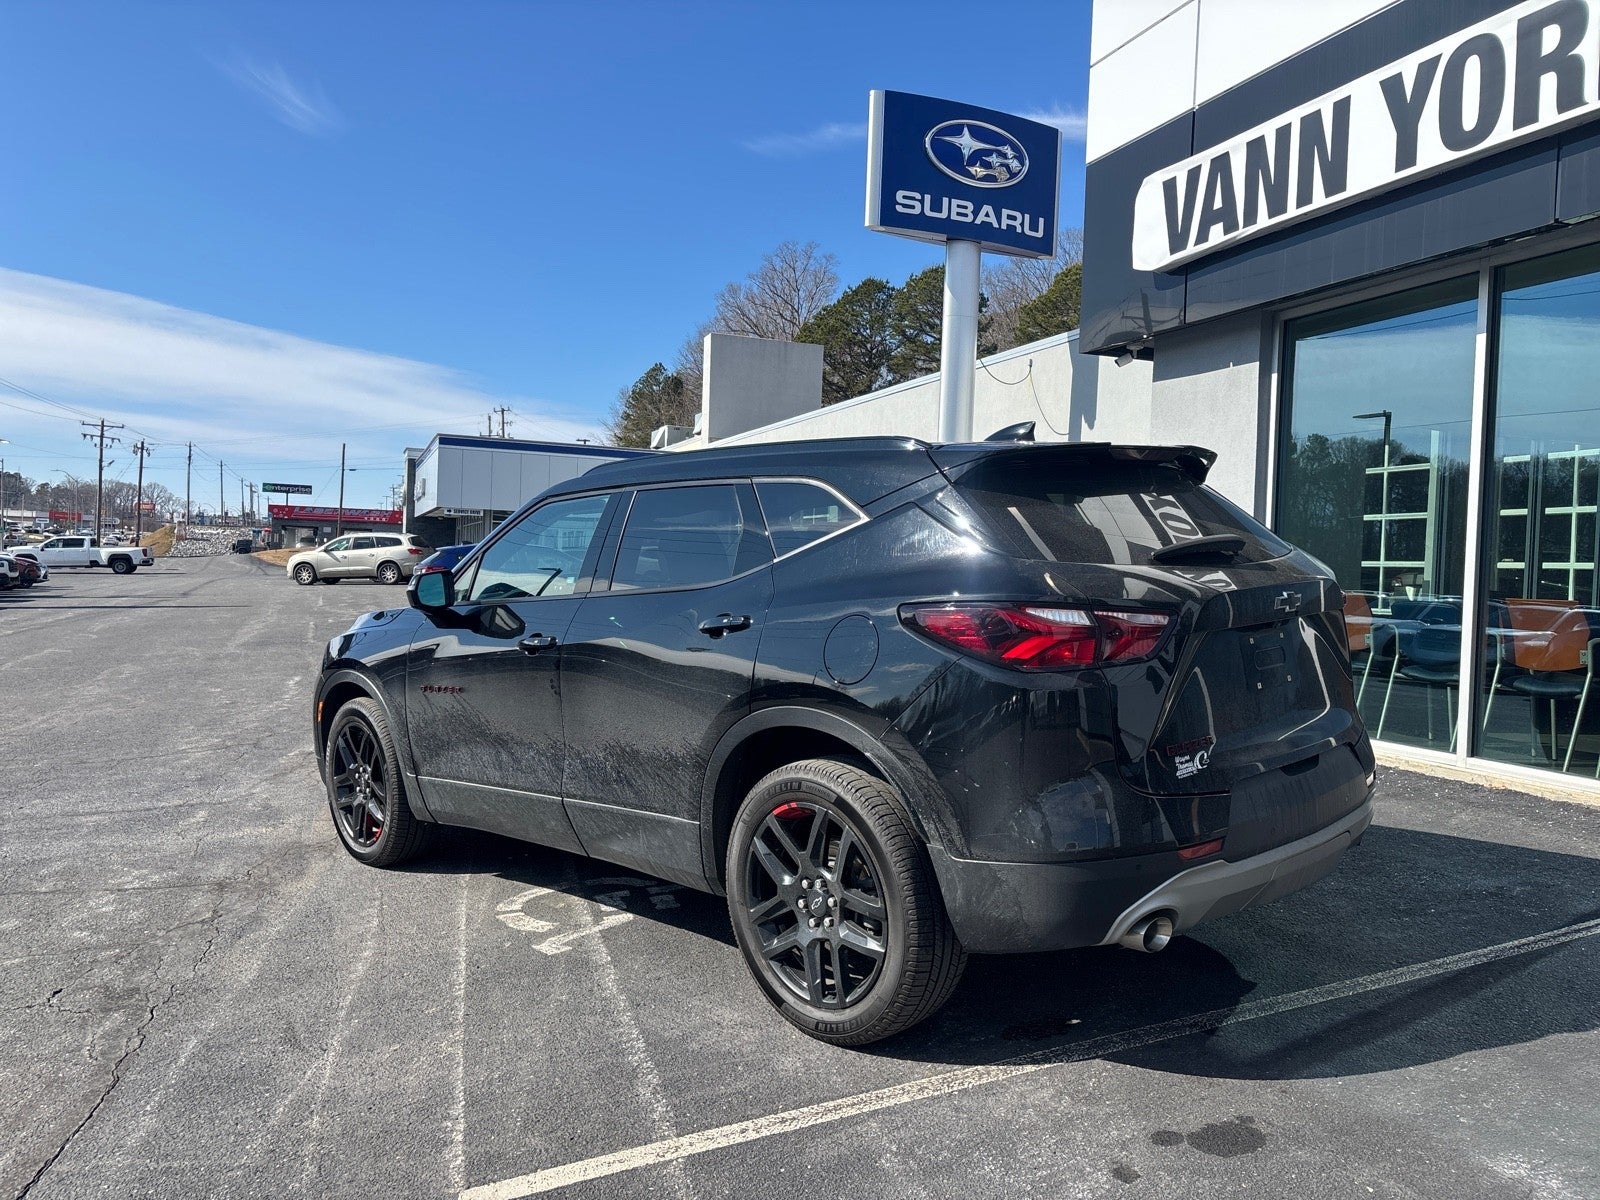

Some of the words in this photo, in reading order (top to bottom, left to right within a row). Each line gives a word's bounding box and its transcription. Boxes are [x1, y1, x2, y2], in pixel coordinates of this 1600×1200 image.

[1162, 94, 1351, 255] VANN
[1379, 0, 1600, 173] YOR
[895, 190, 1044, 238] SUBARU
[264, 484, 311, 492] enterprise
[757, 782, 799, 803] ICHELIN
